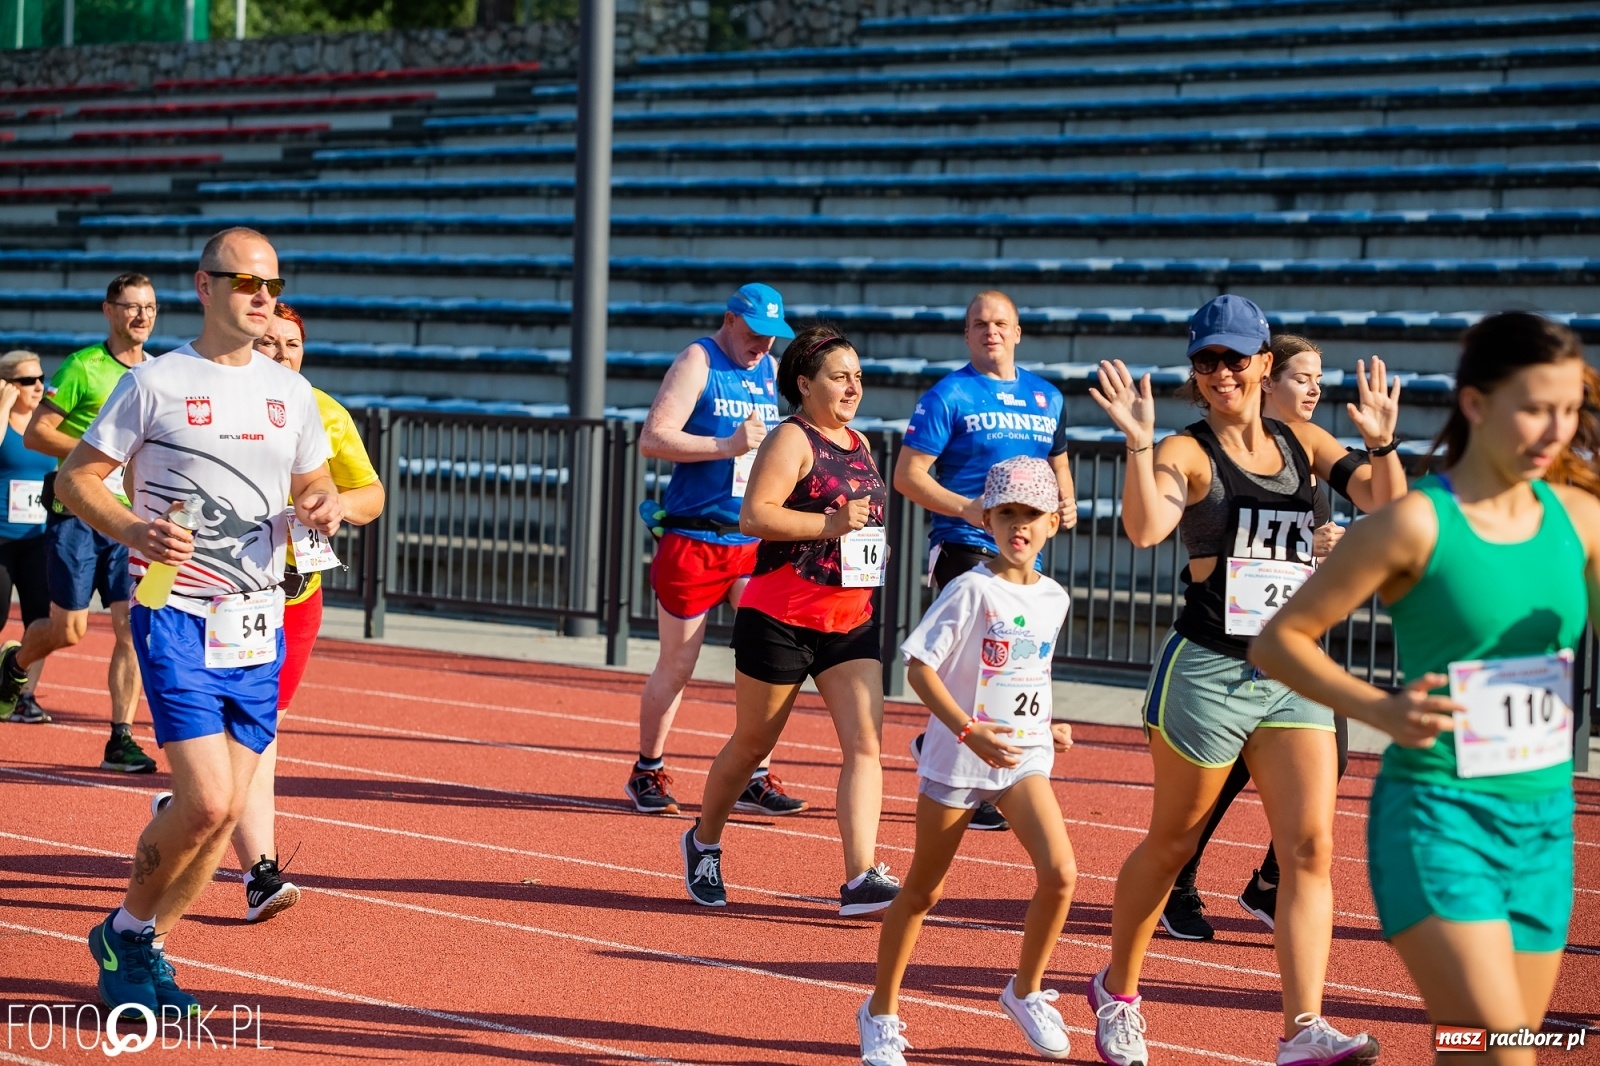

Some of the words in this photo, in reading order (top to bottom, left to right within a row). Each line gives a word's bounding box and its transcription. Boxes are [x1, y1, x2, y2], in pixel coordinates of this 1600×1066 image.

[964, 411, 1057, 435] RUNNERS
[1233, 507, 1315, 562] LET'S
[862, 544, 877, 565] 16
[242, 613, 267, 639] 54
[1013, 692, 1040, 717] 26
[1502, 688, 1554, 728] 110
